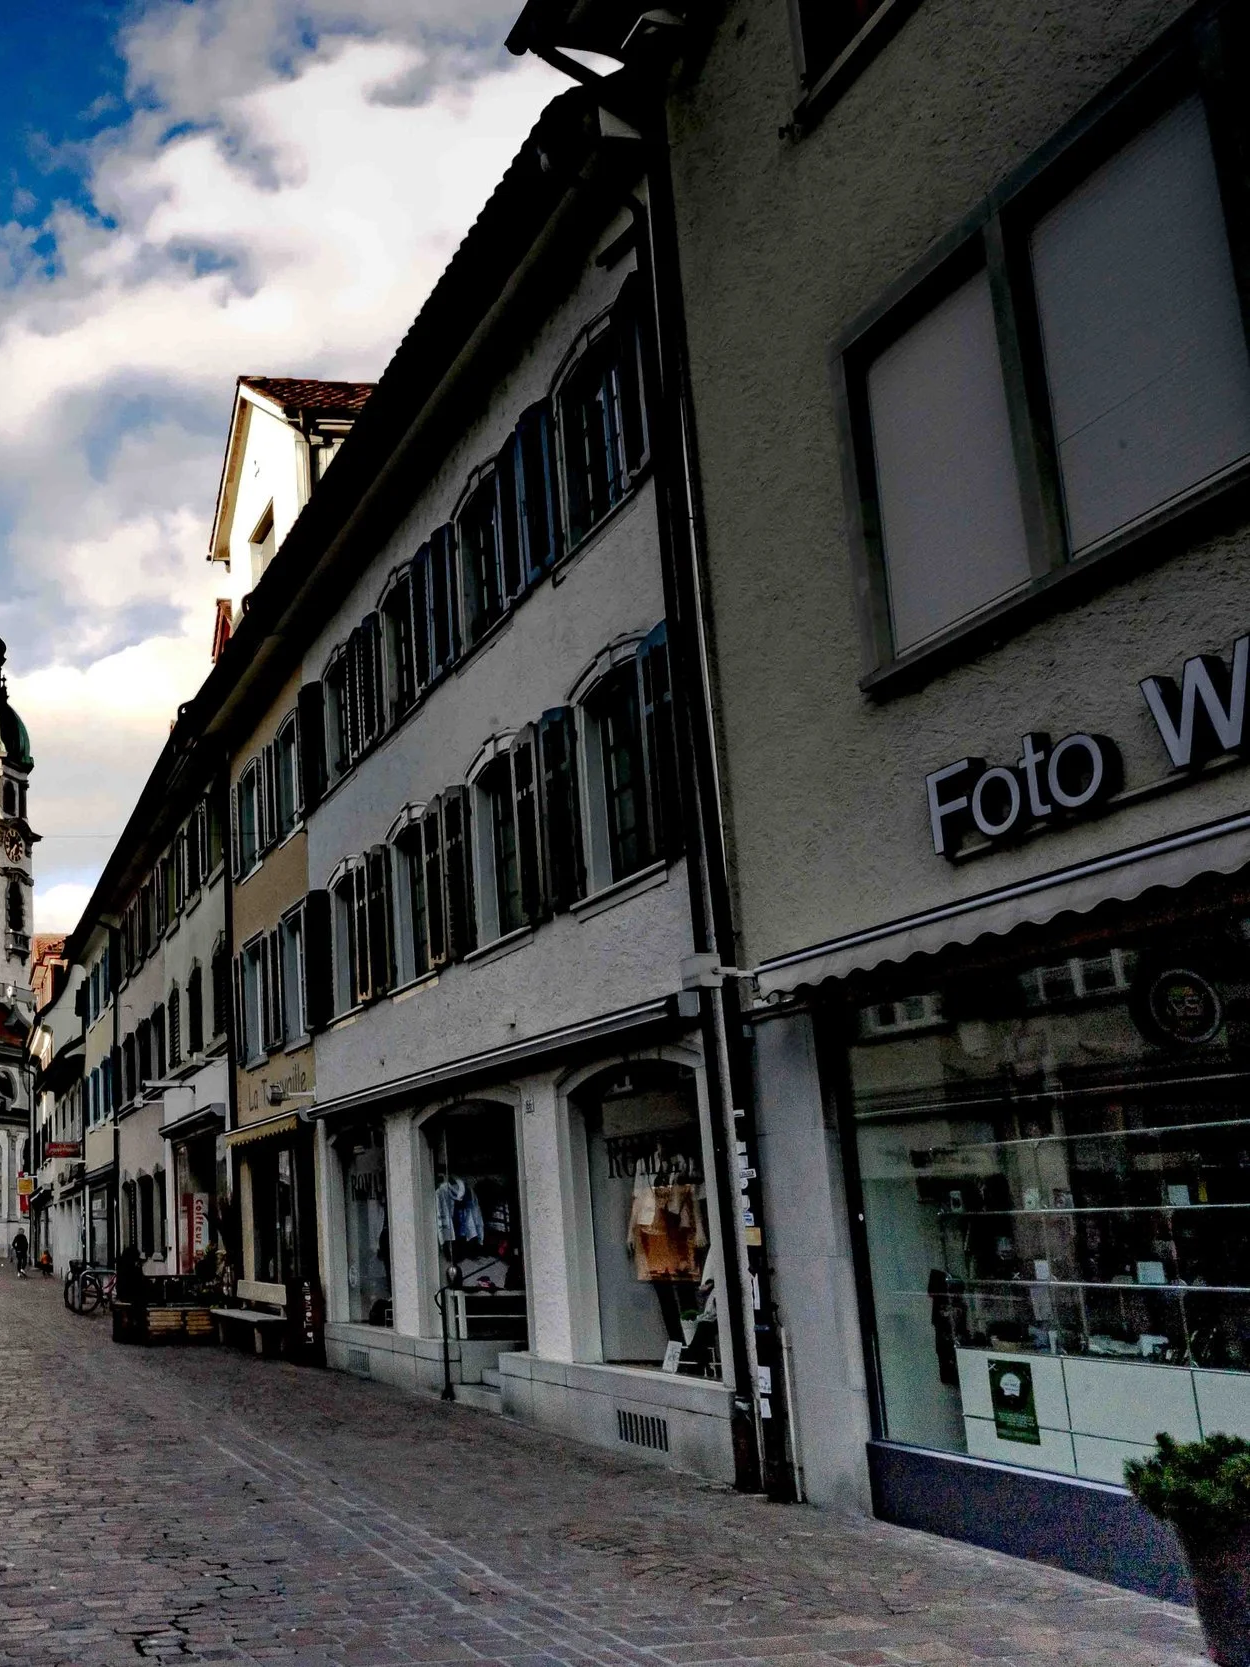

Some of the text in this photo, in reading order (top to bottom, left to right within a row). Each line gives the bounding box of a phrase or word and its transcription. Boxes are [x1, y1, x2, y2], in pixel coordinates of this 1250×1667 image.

[926, 733, 1105, 856] Foto
[196, 1199, 204, 1245] Coiffeur
[302, 1280, 314, 1344] La Trouvaille
